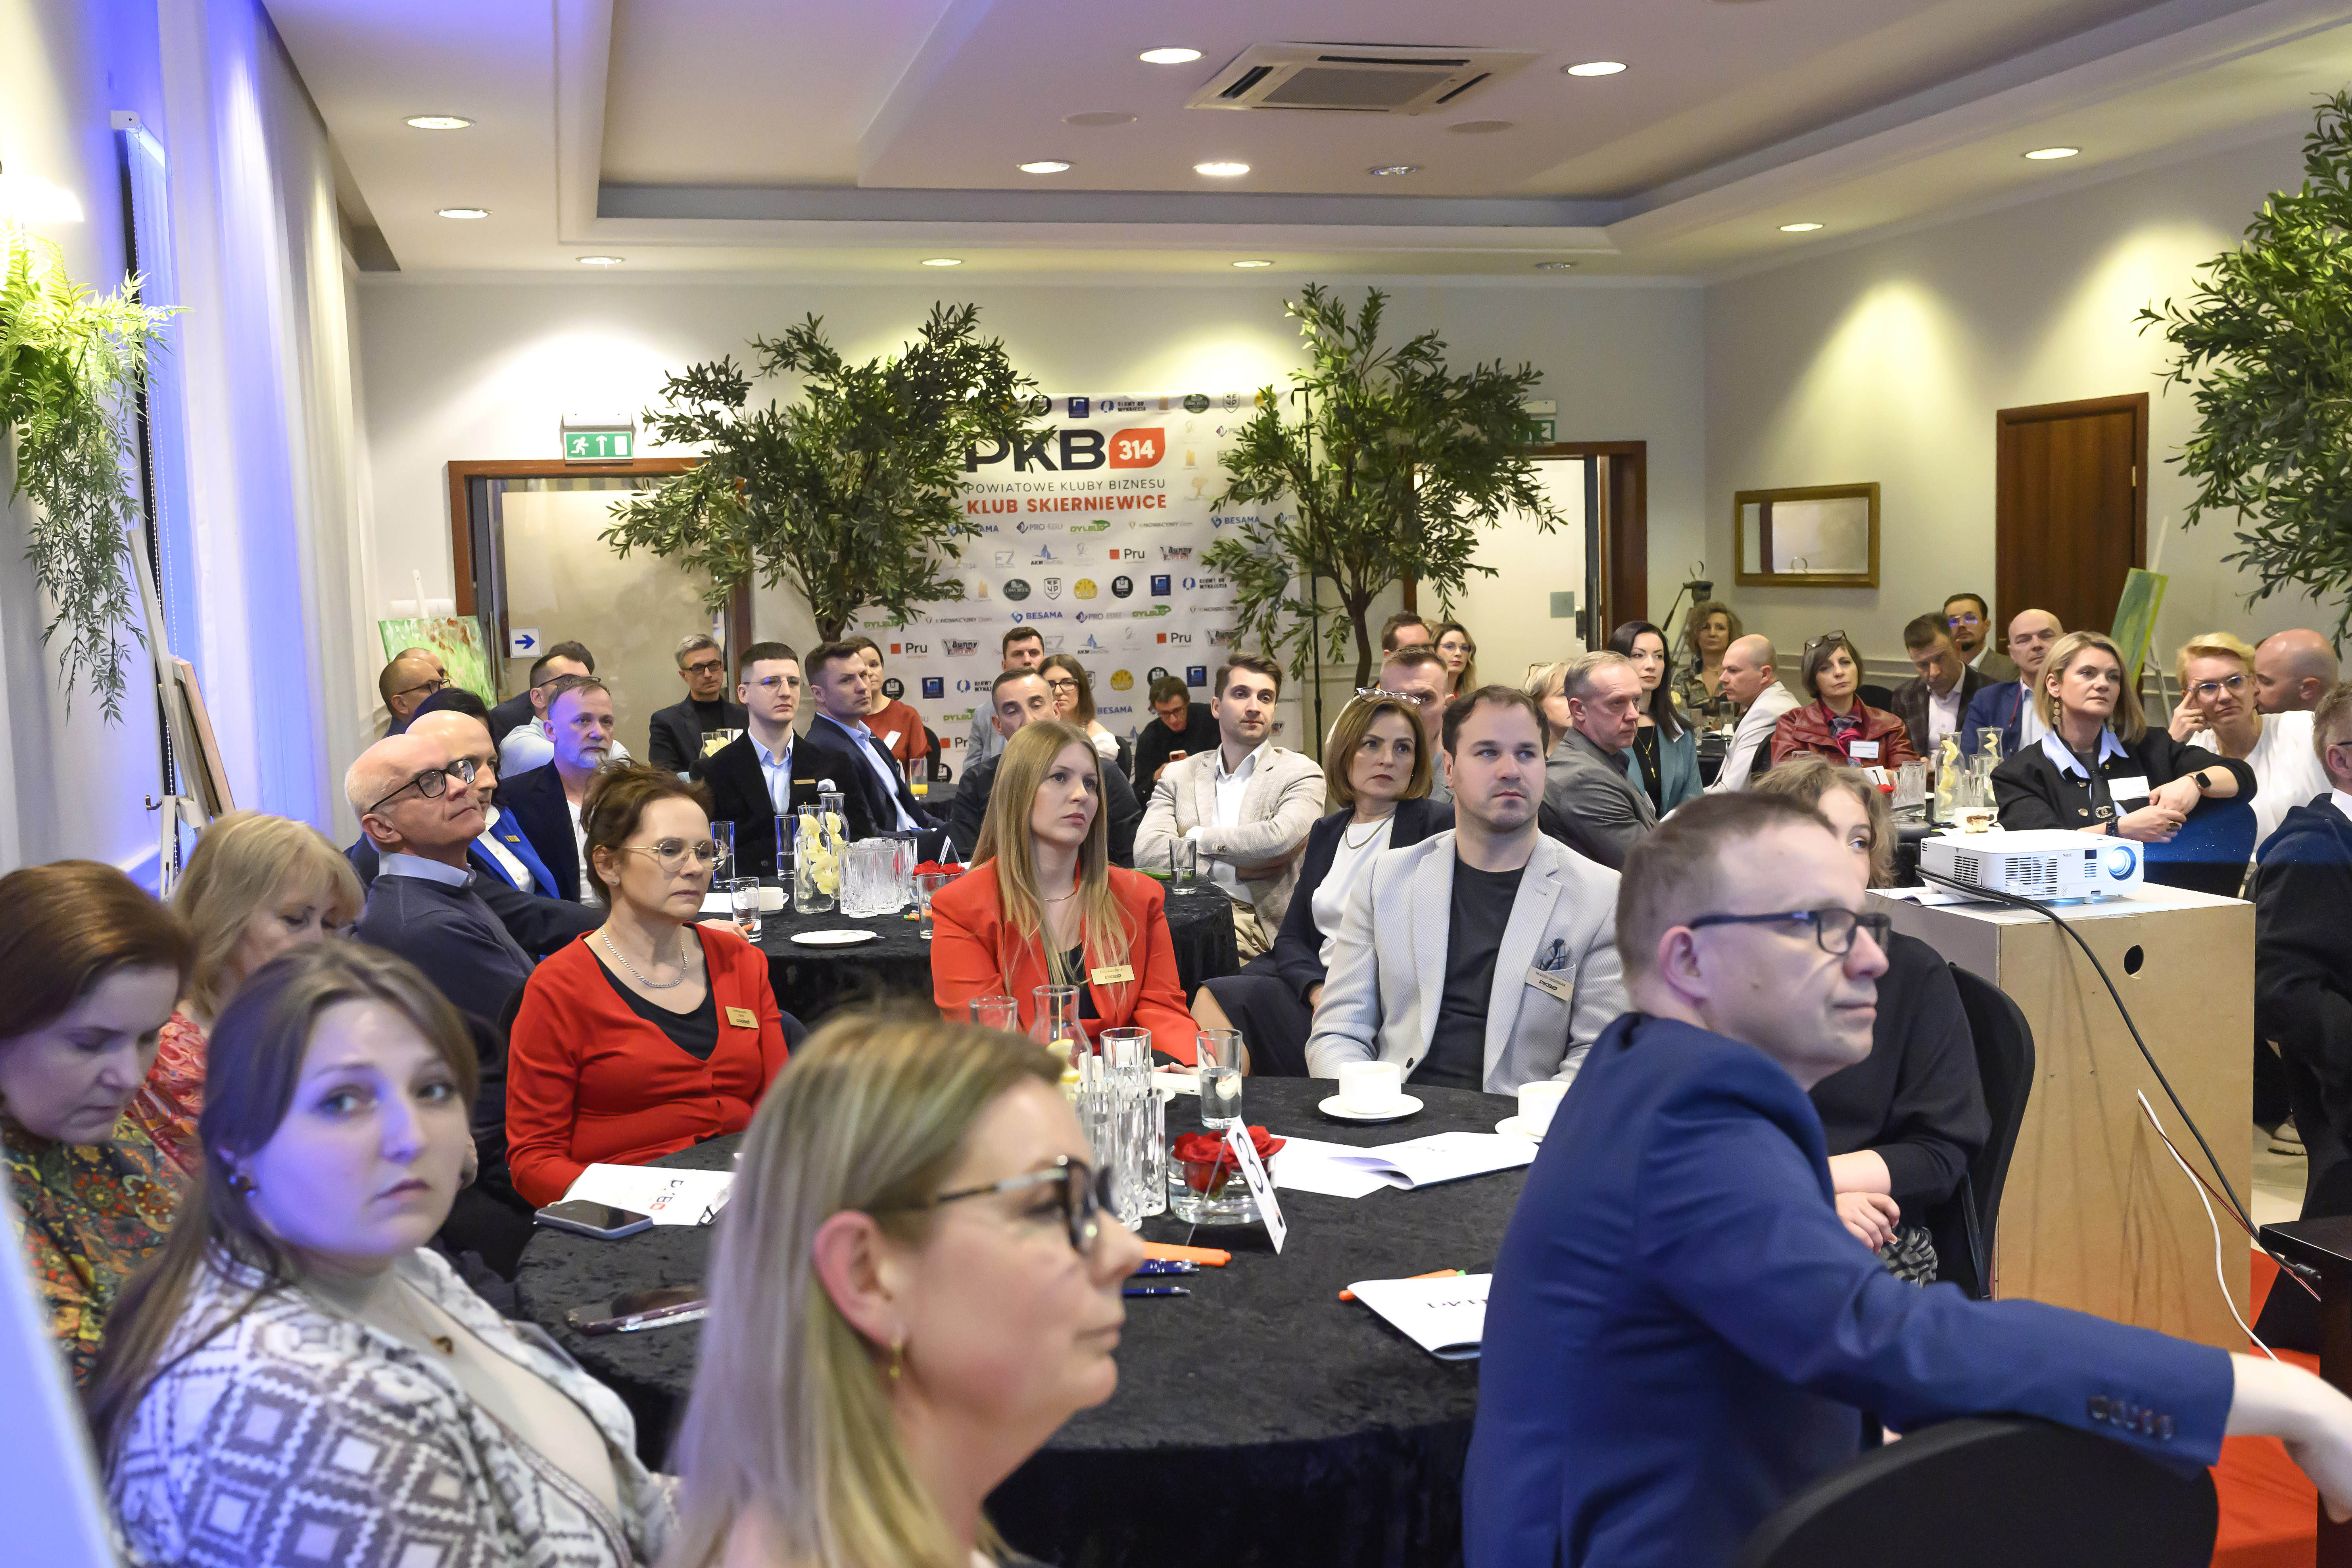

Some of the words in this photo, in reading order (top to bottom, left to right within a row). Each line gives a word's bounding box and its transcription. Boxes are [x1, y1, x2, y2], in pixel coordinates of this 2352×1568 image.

[965, 429, 1106, 473] PKB
[1118, 440, 1155, 460] 314
[967, 482, 1055, 494] POWIATOWE
[1061, 480, 1103, 491] KLUBY
[1109, 479, 1165, 490] BIZNESU
[967, 499, 1018, 514] KLUB
[1027, 494, 1167, 513] SKIERNIEWICE
[1224, 516, 1260, 524] BESAMA
[1124, 548, 1145, 559] Pru
[1171, 632, 1191, 643] Pru
[905, 643, 927, 654] Pru
[1097, 706, 1133, 714] BESAMA
[955, 737, 968, 748] Pr
[1236, 1132, 1263, 1194] 3
